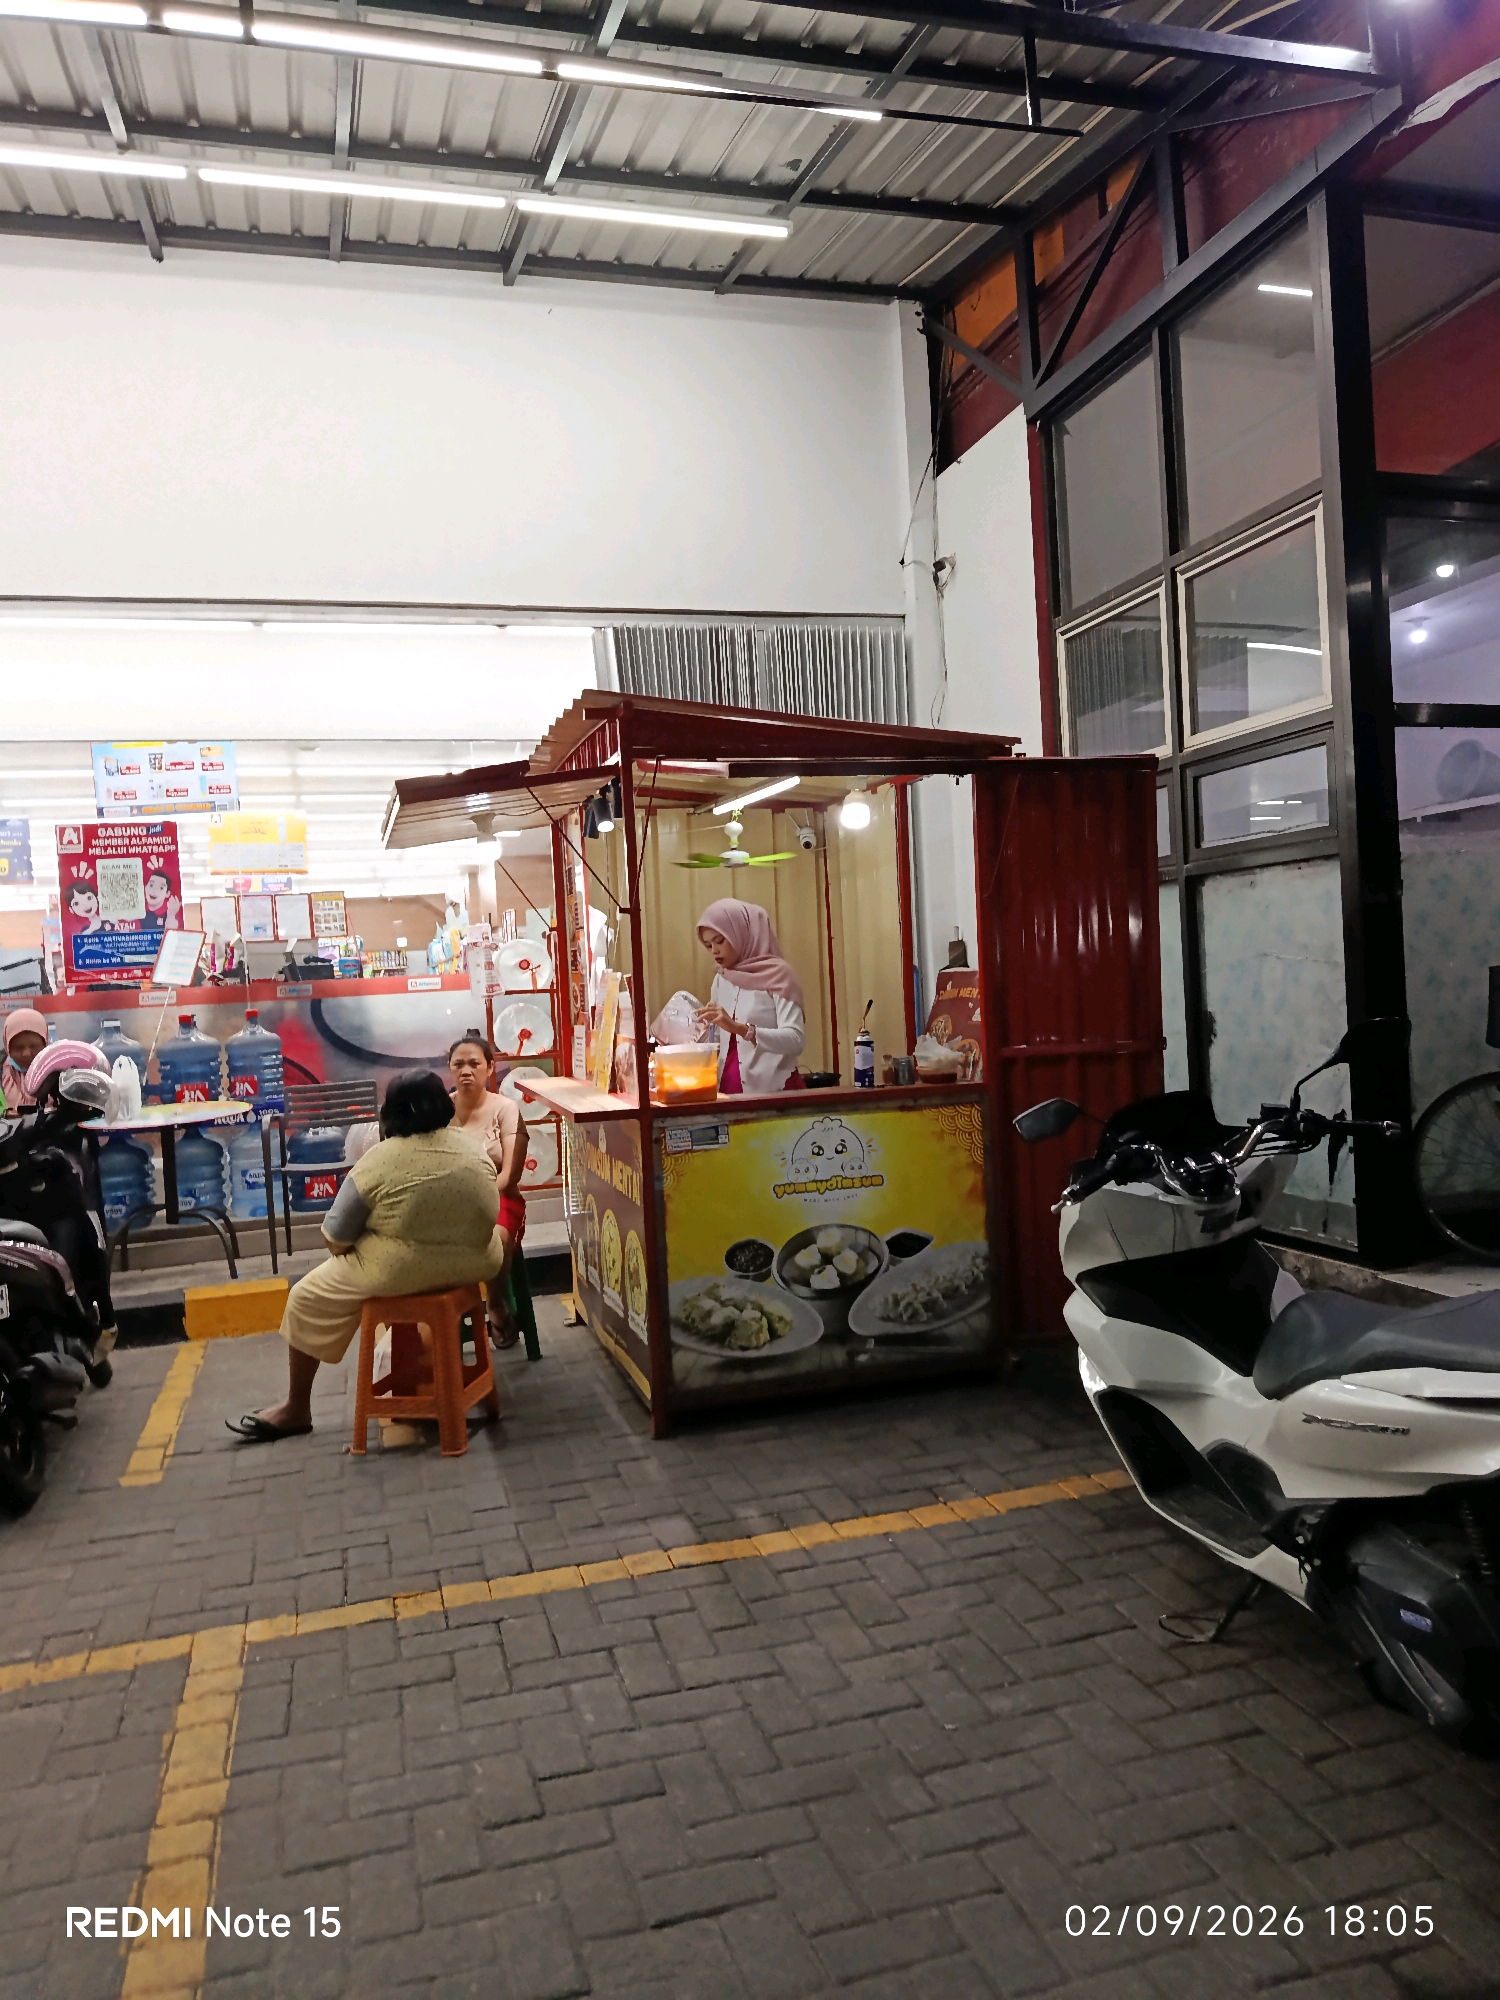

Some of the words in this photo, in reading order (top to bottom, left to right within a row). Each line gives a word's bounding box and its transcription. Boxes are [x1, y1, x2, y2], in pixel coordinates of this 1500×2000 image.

[97, 826, 147, 837] GABUNG
[92, 837, 129, 847] MEMBER
[130, 836, 172, 845] ALFAMIDI
[88, 846, 126, 856] MELALUI
[128, 844, 176, 854] WHATSAPP
[114, 922, 136, 931] ATAU
